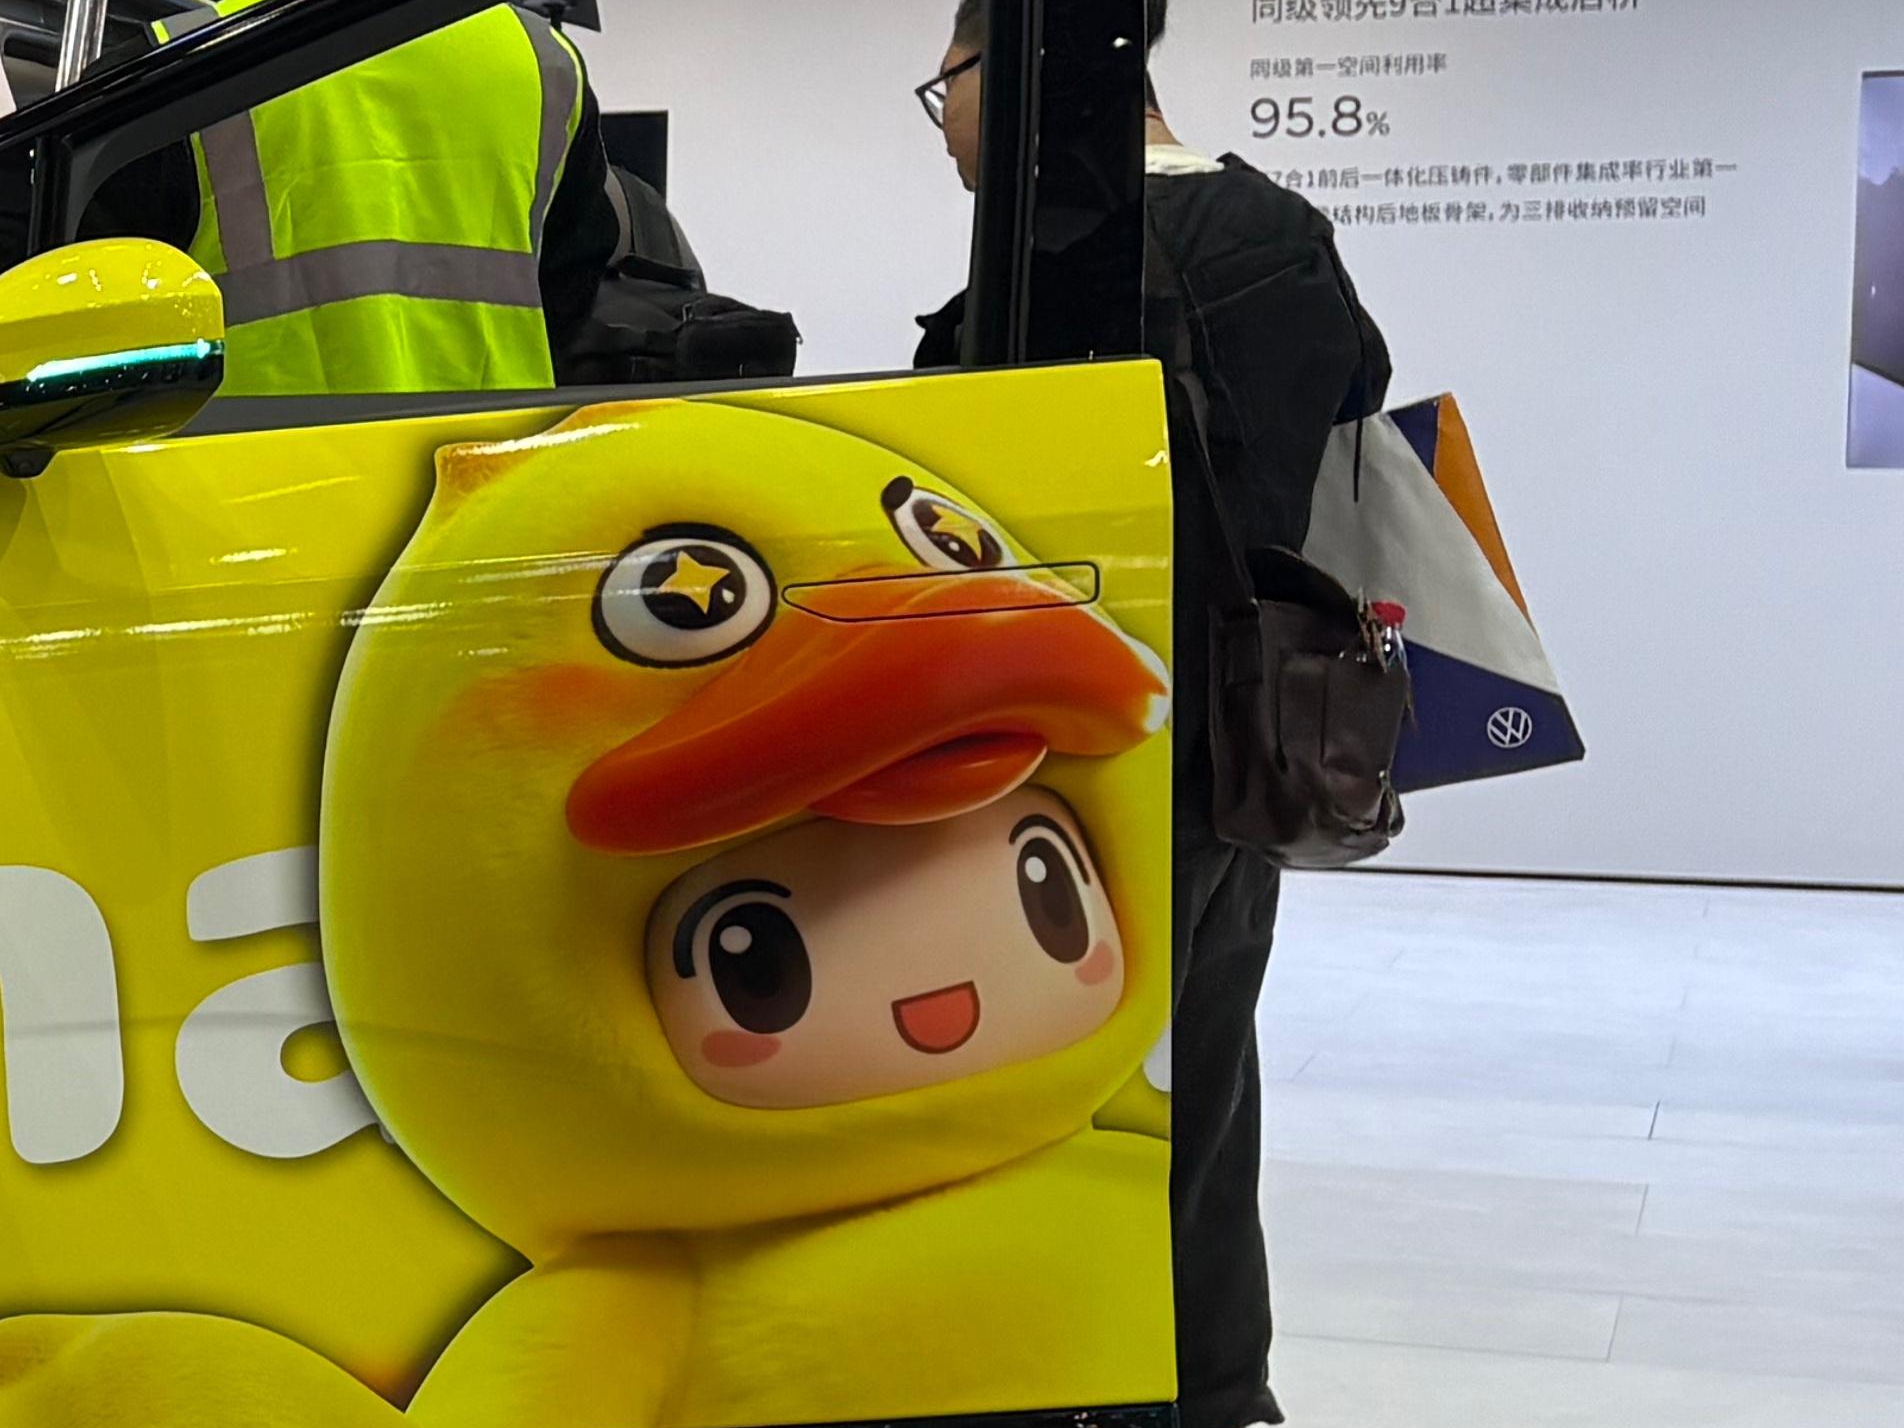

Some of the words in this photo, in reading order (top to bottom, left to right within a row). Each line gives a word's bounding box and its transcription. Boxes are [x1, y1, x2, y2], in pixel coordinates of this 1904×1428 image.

[1250, 52, 1448, 80] 同级第一空间利用率
[1249, 95, 1391, 139] 95.8%
